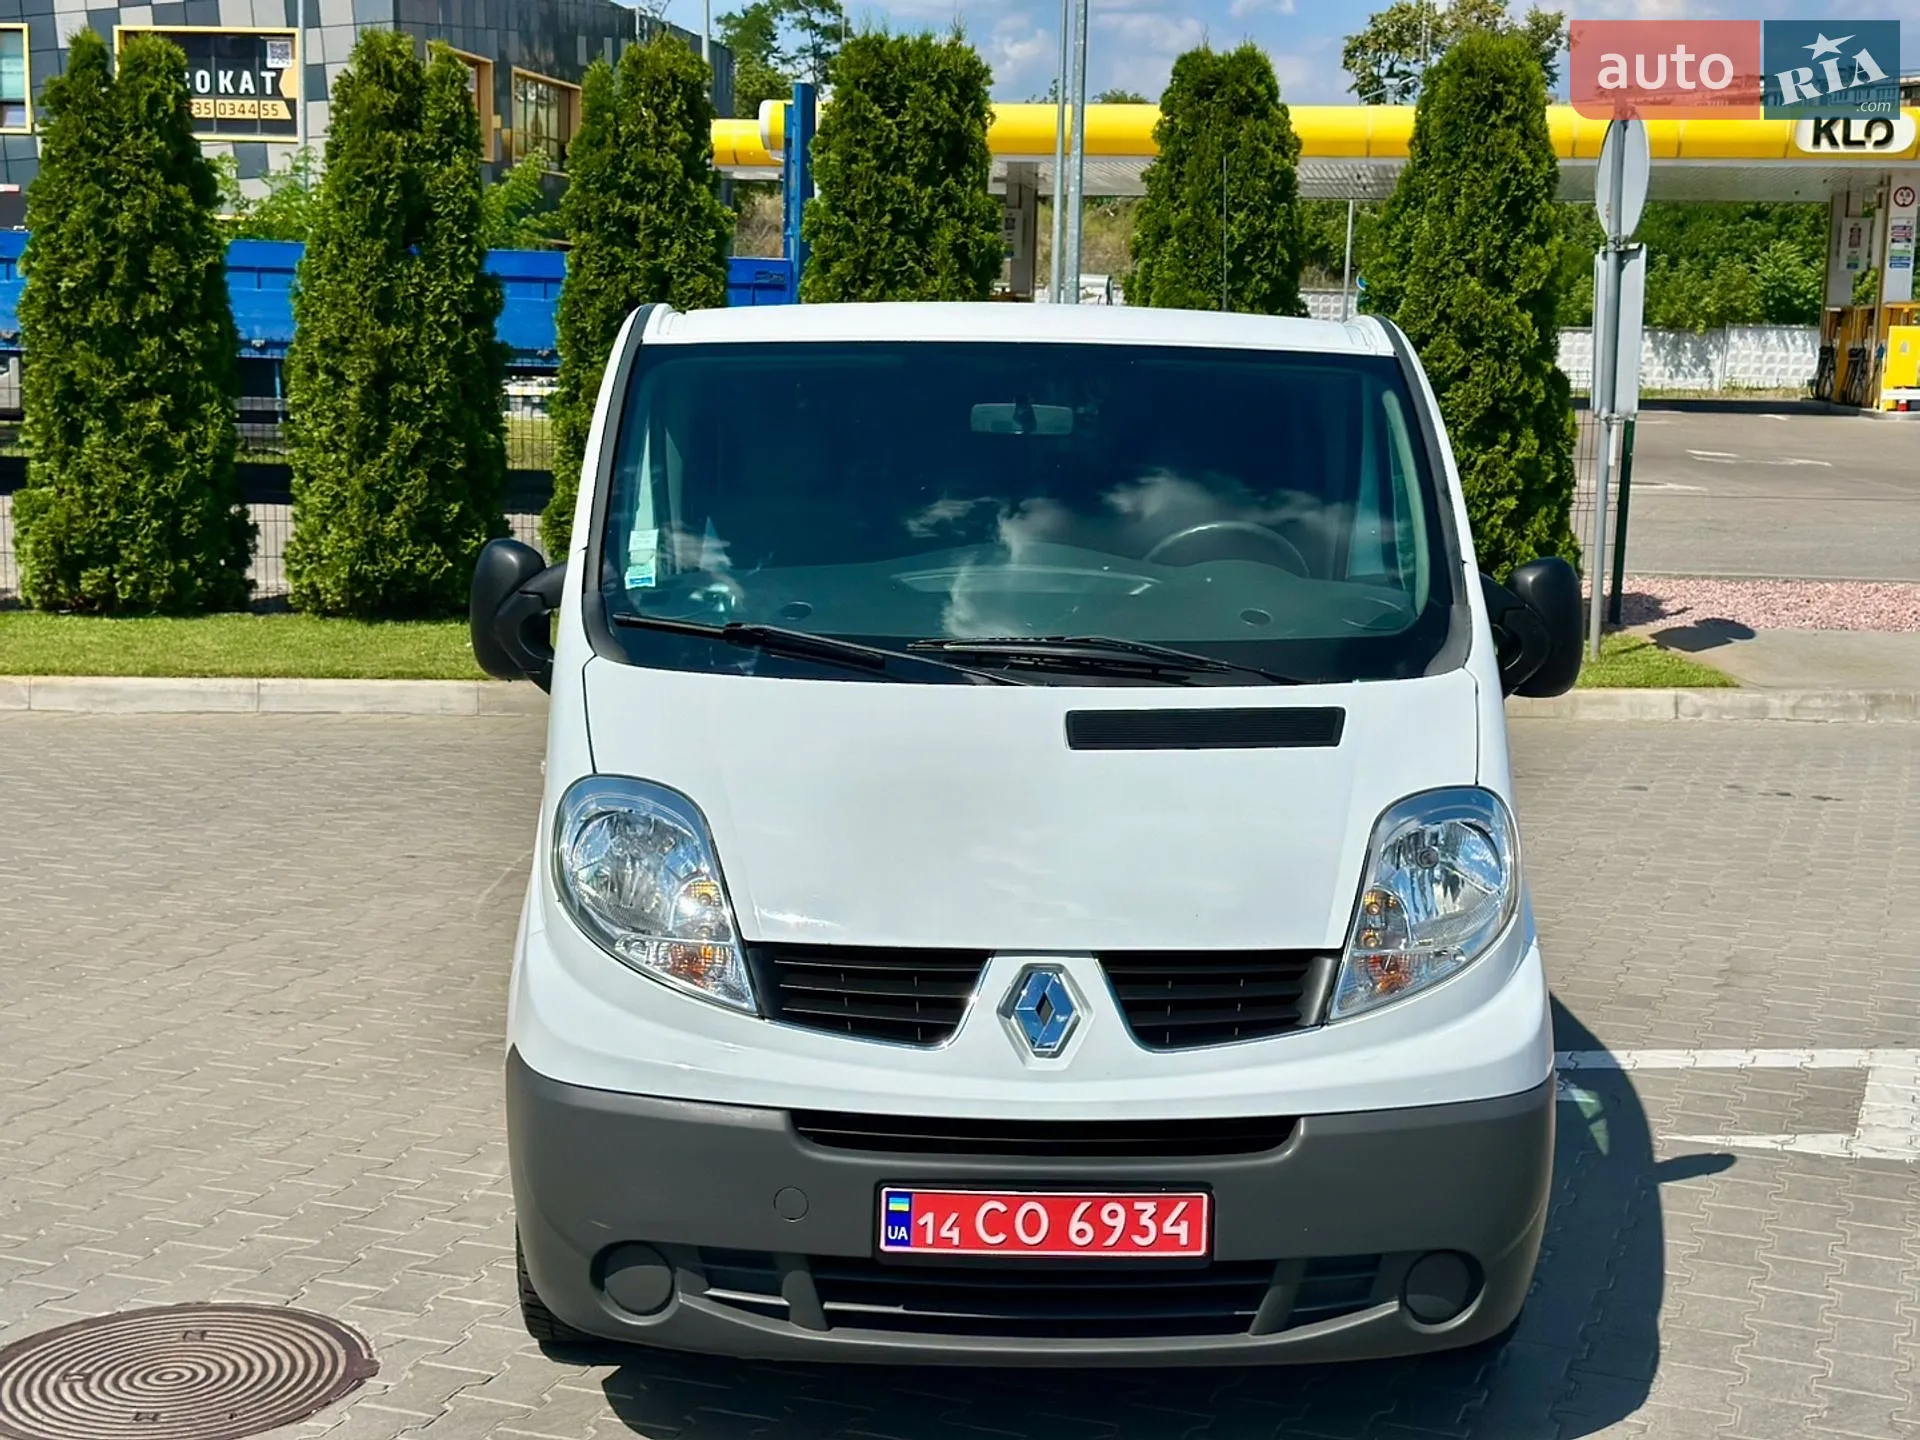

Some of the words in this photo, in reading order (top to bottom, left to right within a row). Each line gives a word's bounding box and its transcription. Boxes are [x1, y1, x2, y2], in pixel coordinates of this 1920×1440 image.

[1812, 115, 1894, 150] KLO
[887, 1224, 908, 1241] UA
[917, 1211, 961, 1246] 14
[974, 1200, 1050, 1246] CO
[1067, 1200, 1190, 1247] 6934
